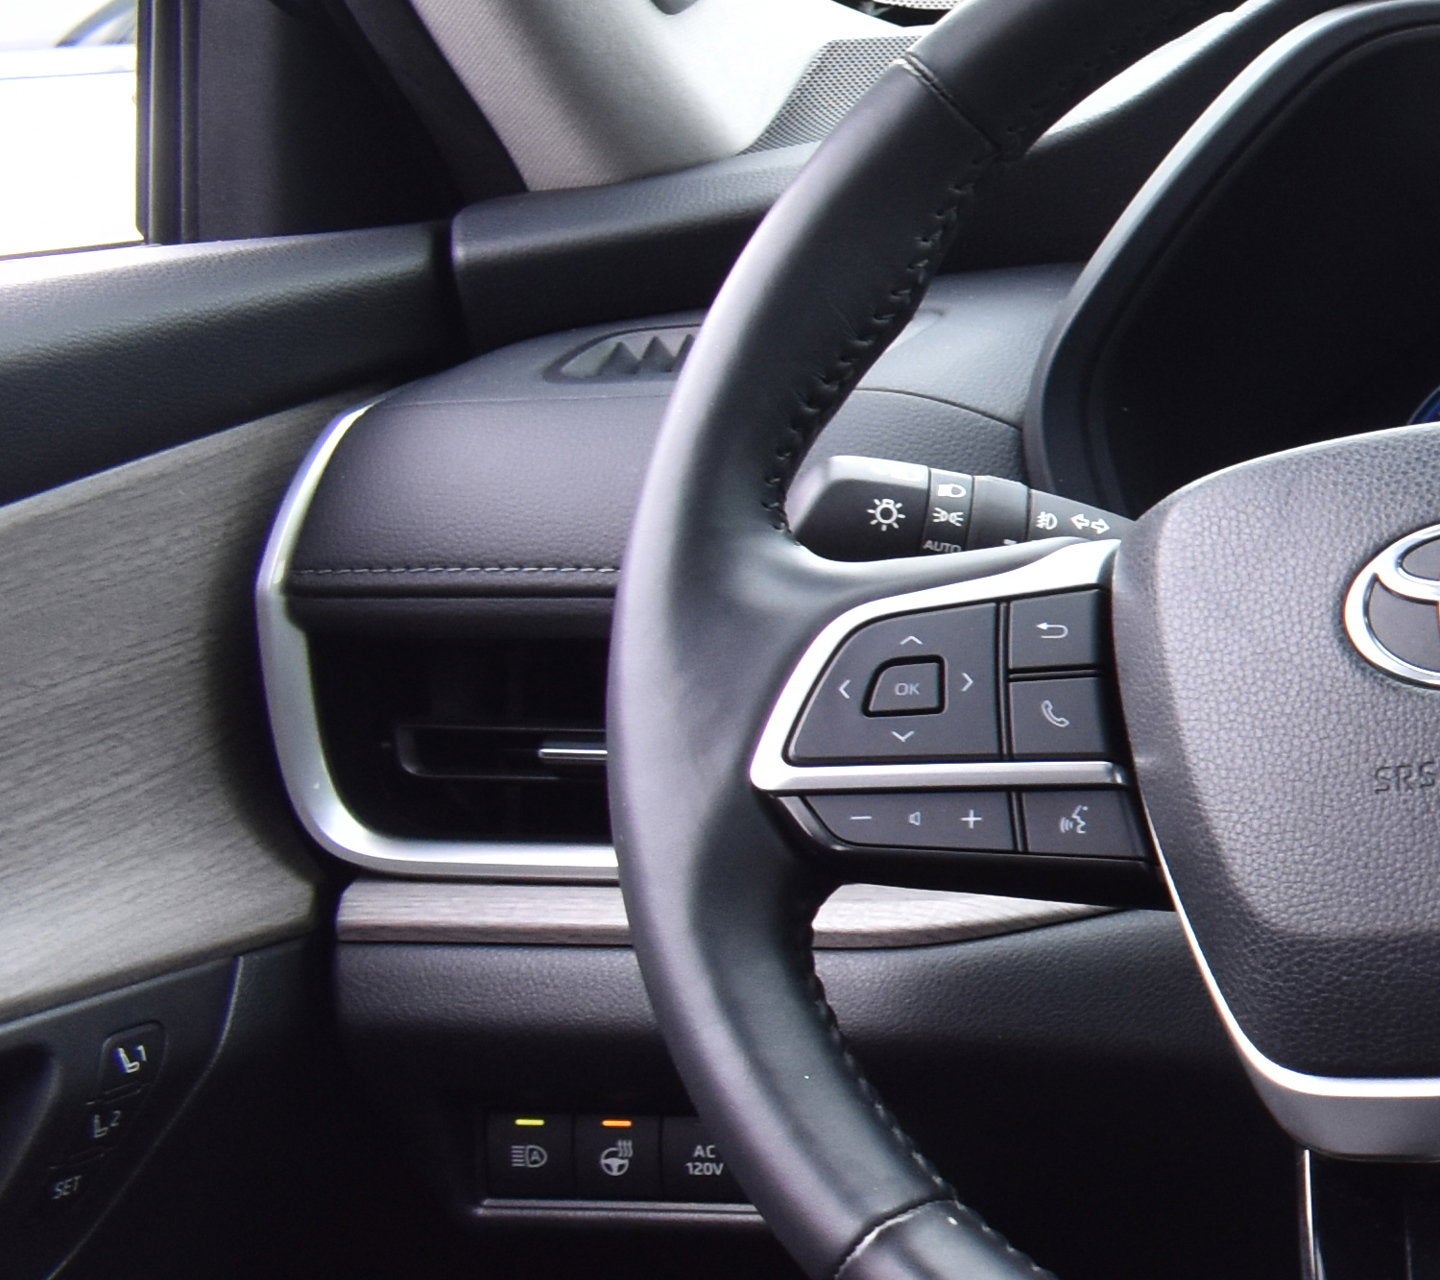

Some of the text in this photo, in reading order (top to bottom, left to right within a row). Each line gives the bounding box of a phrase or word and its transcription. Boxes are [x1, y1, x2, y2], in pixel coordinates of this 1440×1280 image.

[923, 539, 961, 553] AUTO
[894, 681, 920, 697] OK
[1374, 761, 1436, 794] SRS
[693, 1144, 716, 1158] AC
[685, 1162, 724, 1176] 120V
[52, 1175, 82, 1199] SET
